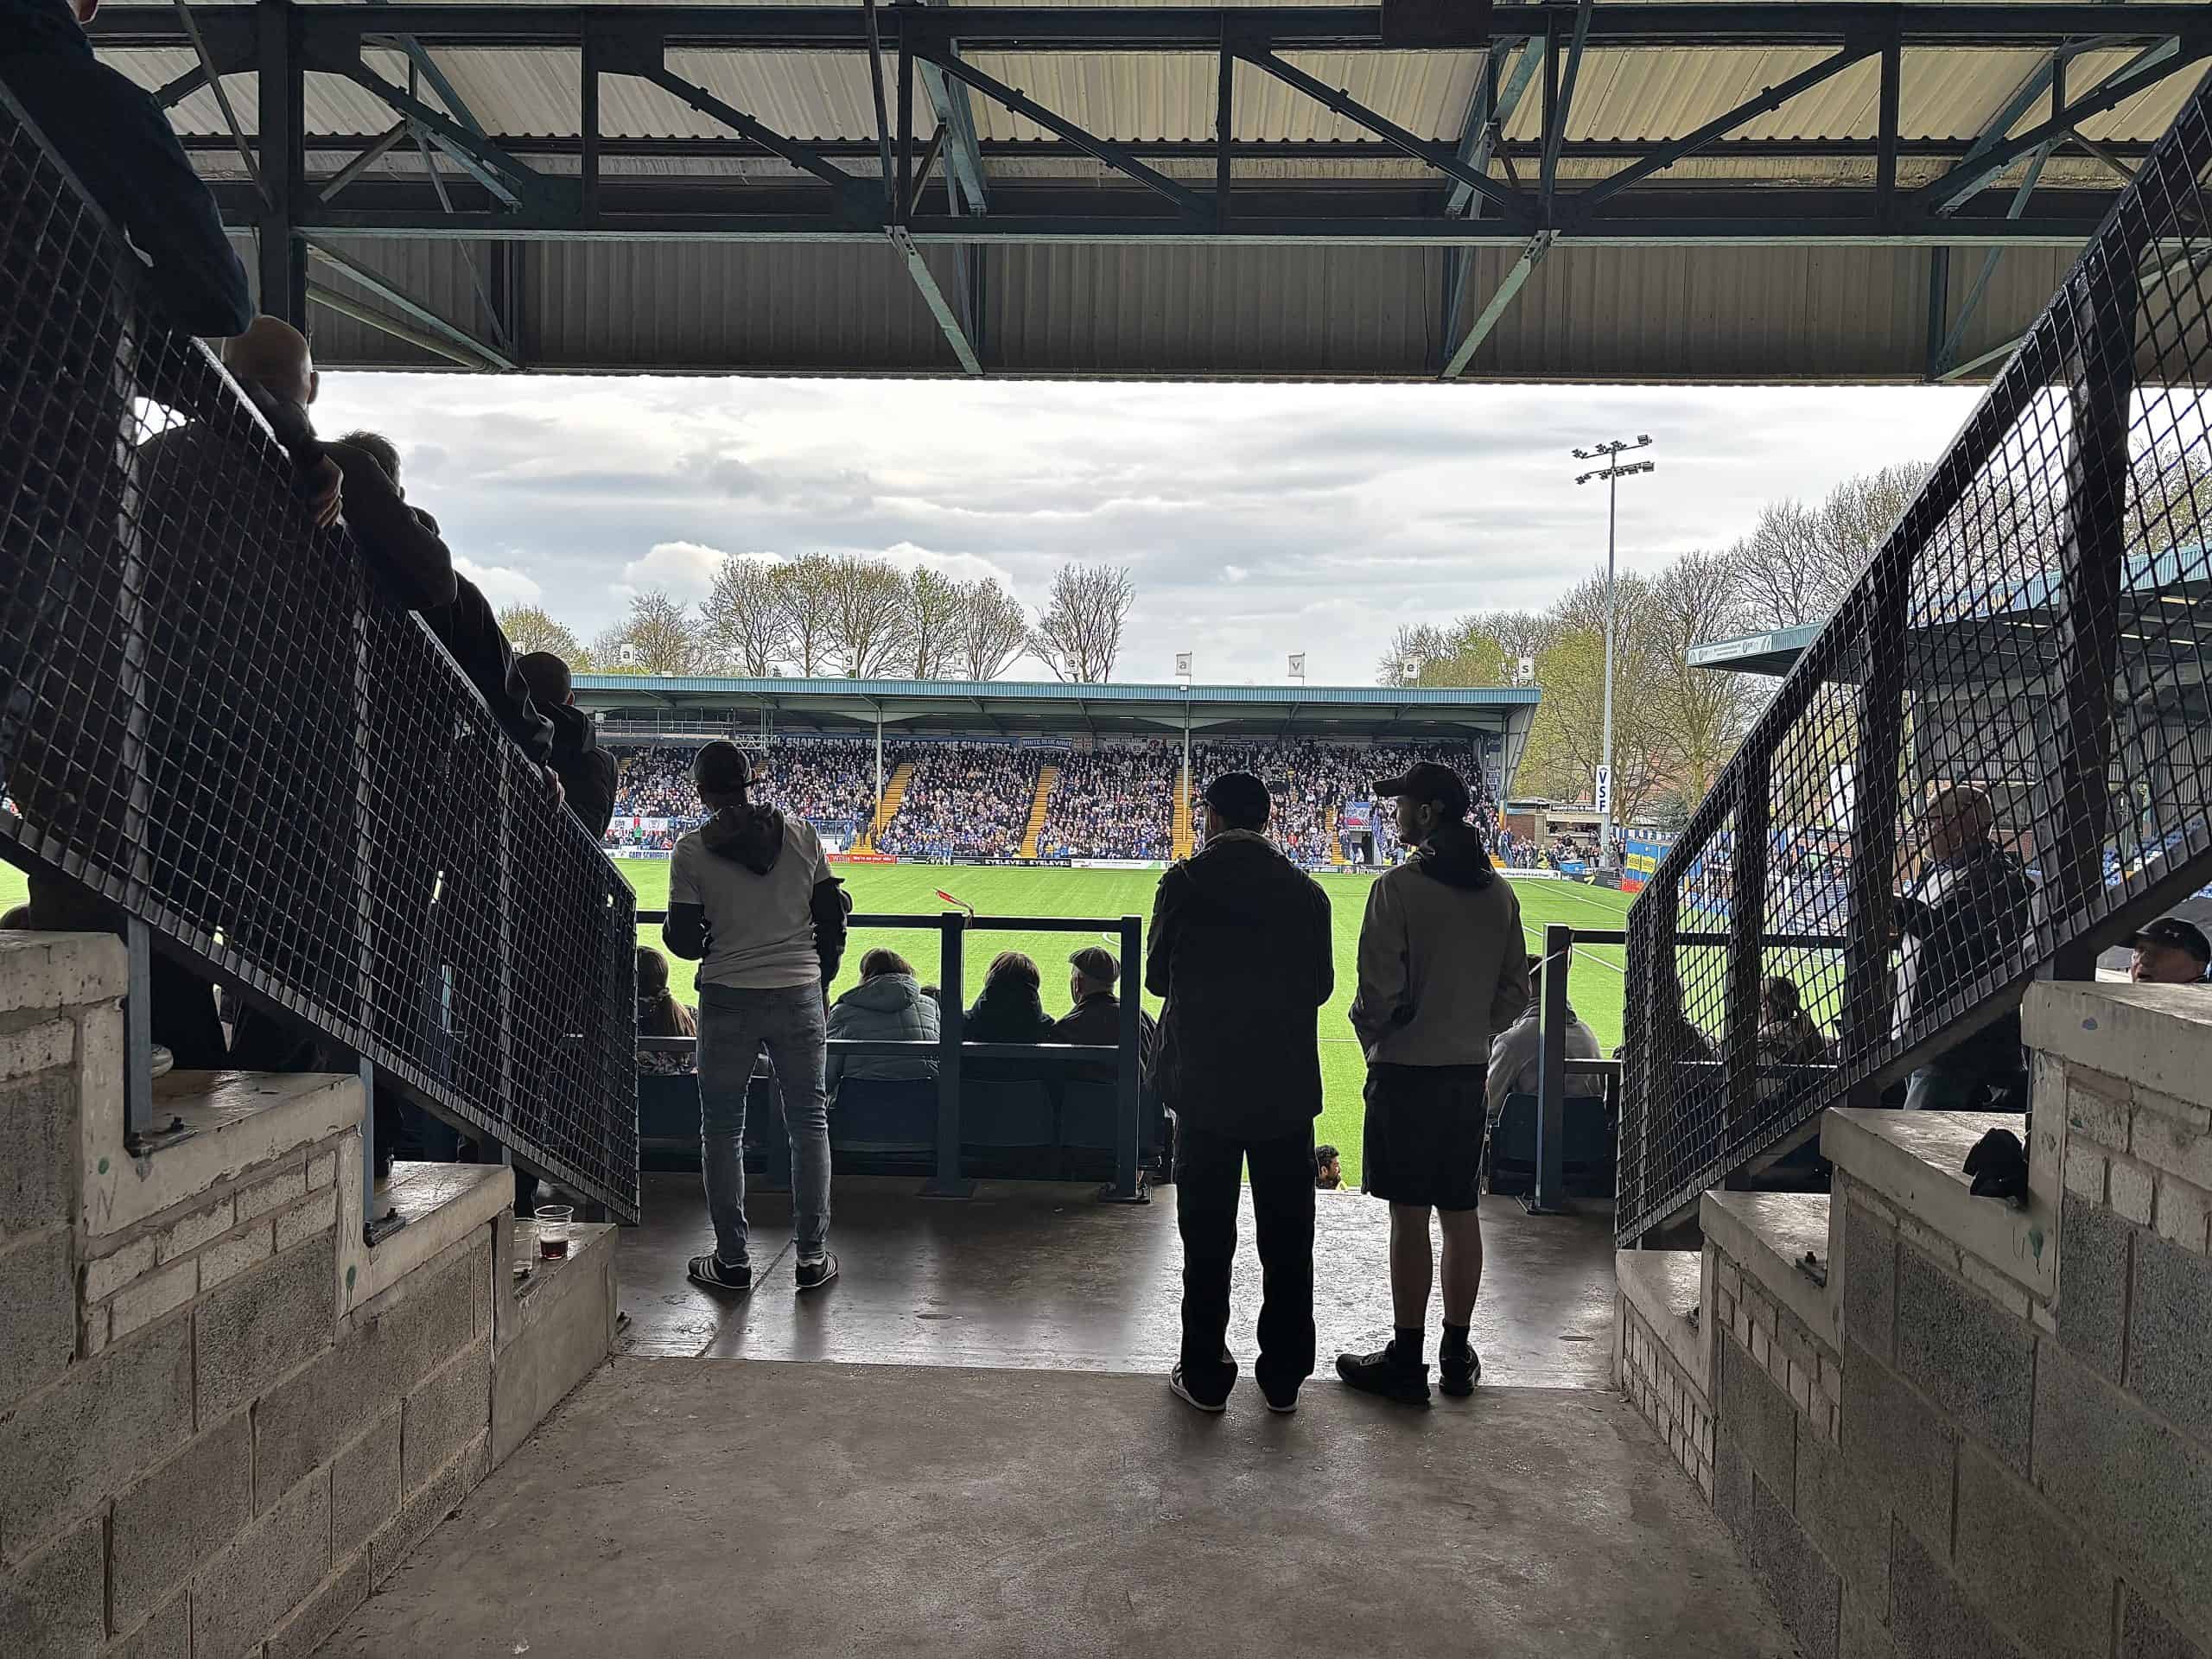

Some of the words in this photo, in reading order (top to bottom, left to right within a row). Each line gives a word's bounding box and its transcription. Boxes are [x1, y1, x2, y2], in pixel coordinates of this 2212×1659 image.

[1179, 661, 1186, 670] a
[1407, 663, 1414, 672] e
[1522, 664, 1529, 673] s
[1599, 771, 1607, 812] VSF
